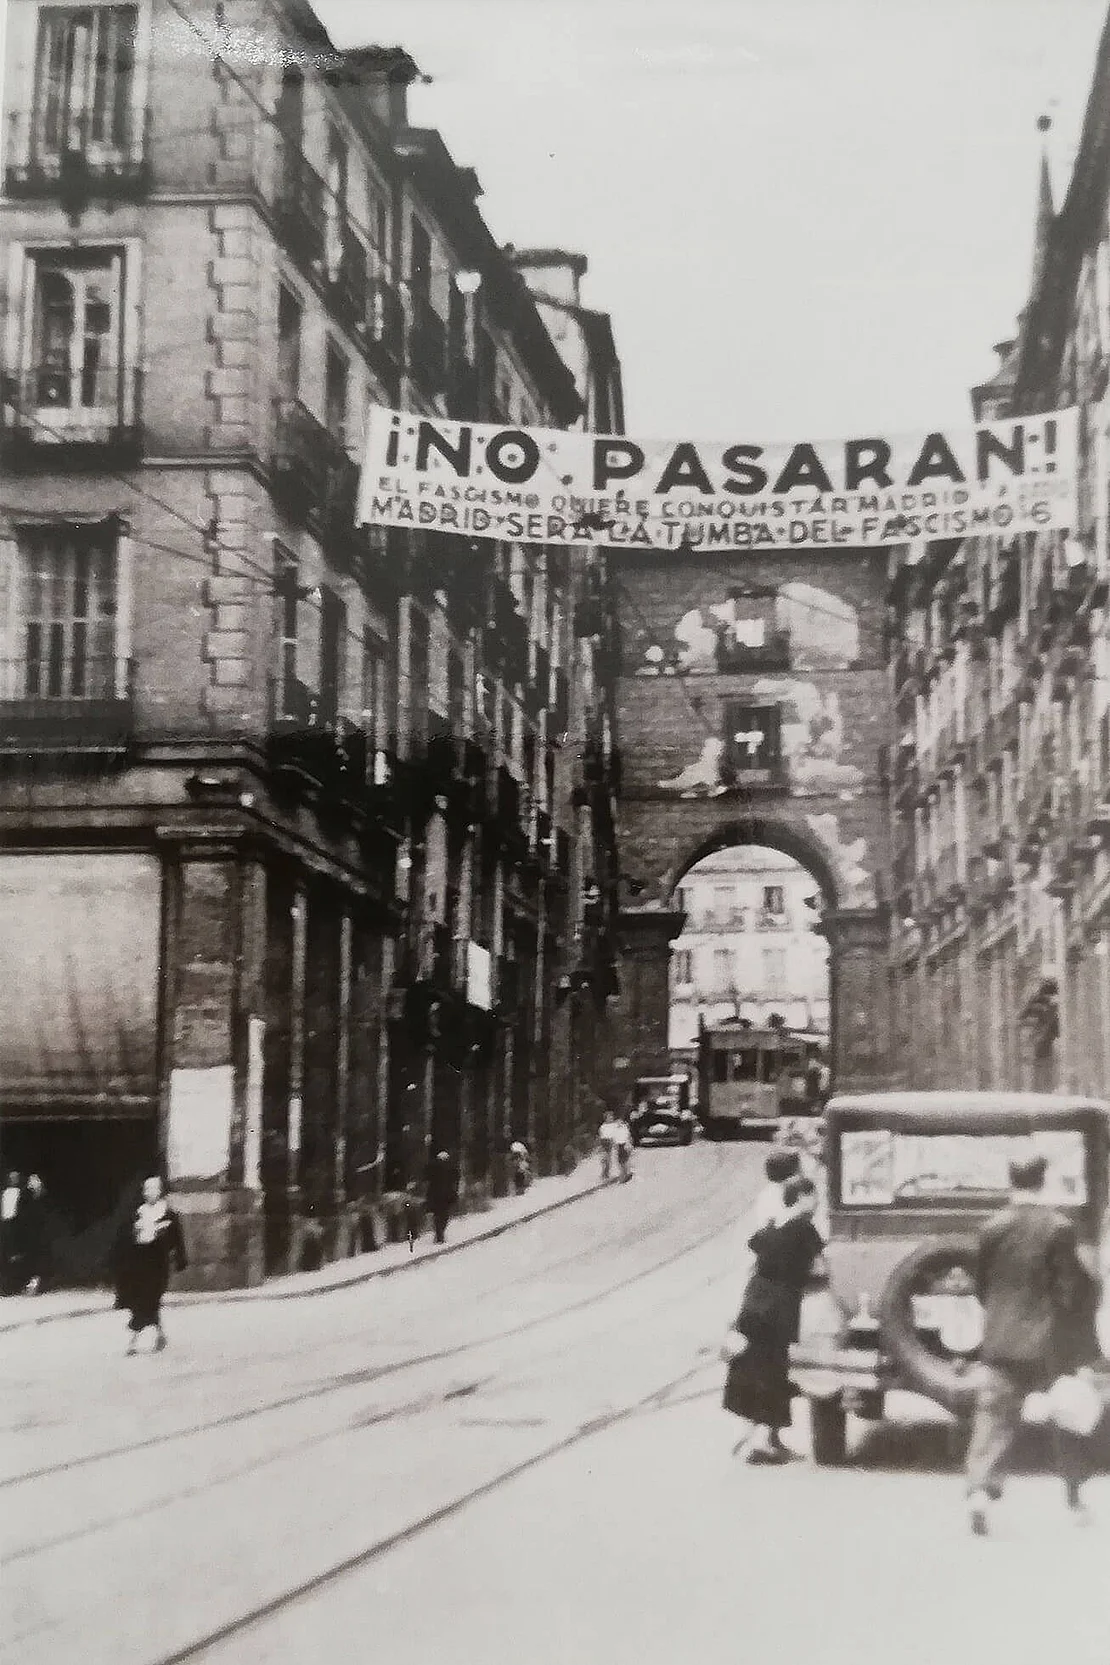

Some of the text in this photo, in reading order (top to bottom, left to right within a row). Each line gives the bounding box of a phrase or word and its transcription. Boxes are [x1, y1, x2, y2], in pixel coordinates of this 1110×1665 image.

[592, 419, 1057, 495] PASARAN!
[371, 495, 491, 531] MADRID
[661, 520, 775, 548] TUMBA
[790, 518, 848, 543] DEL
[860, 503, 1014, 541] FASCISMO
[379, 476, 408, 494] EL
[418, 481, 540, 509] FASCISMO
[662, 496, 847, 519] CONQUISTAR
[857, 489, 969, 512] MADRID
